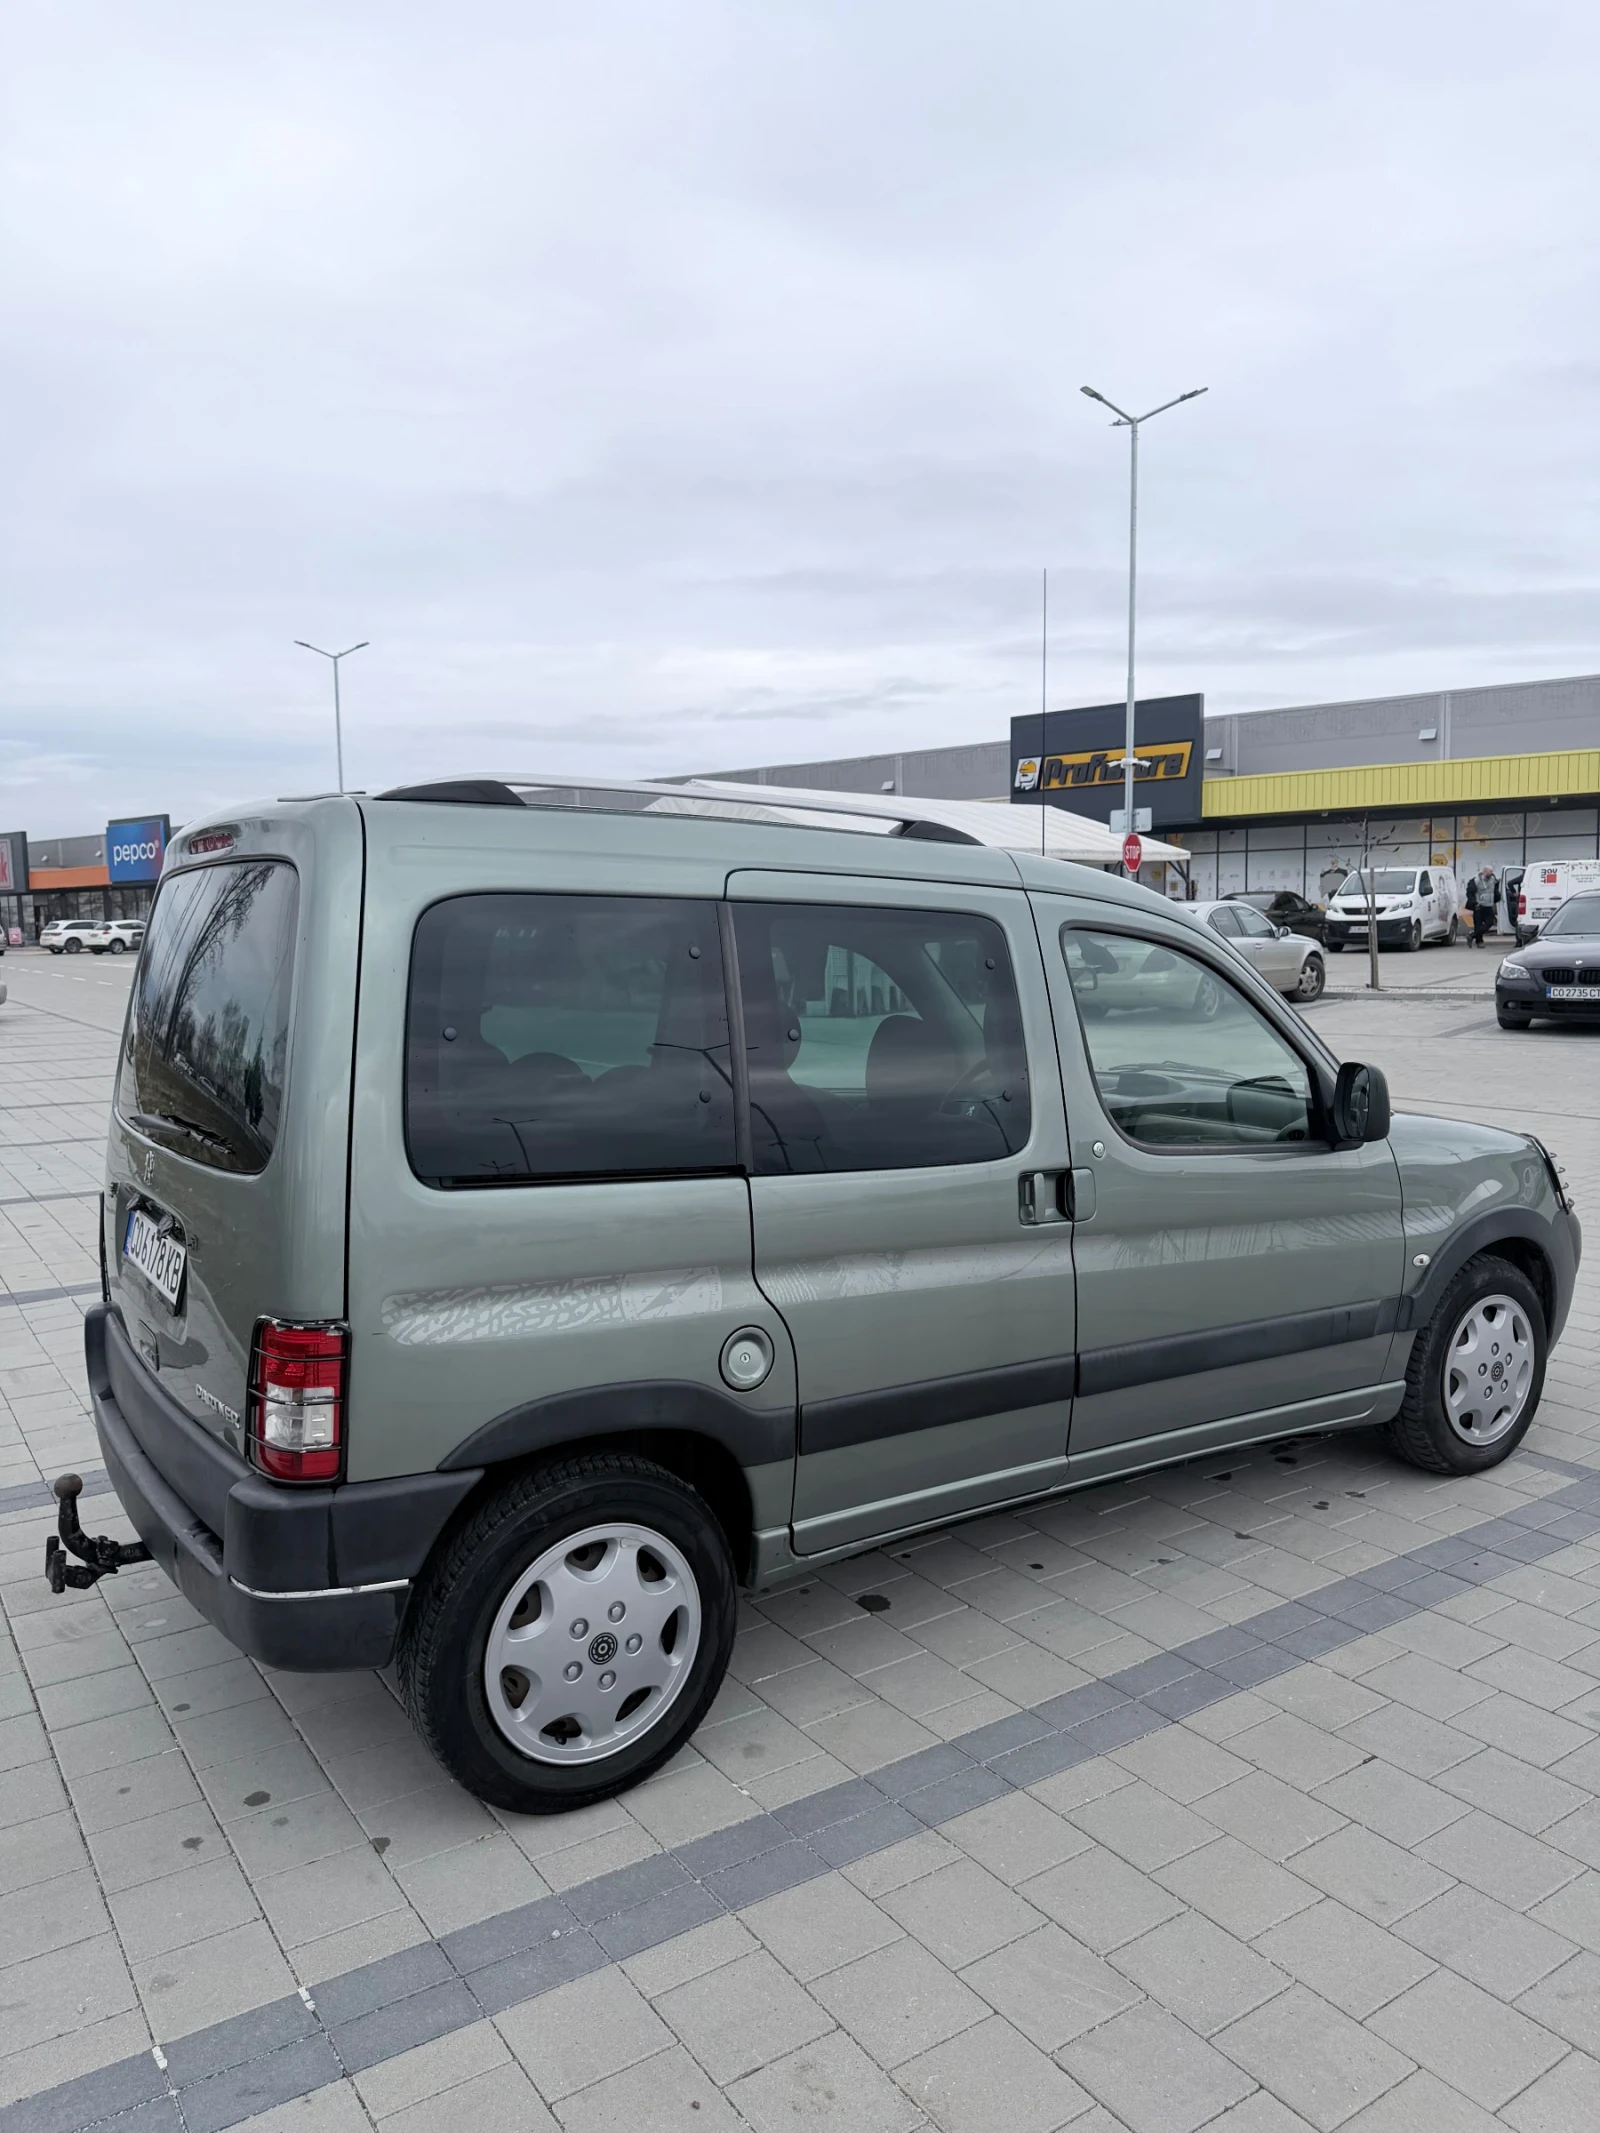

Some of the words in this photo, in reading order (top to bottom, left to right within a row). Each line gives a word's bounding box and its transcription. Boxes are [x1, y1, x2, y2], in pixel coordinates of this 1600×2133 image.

[1044, 750, 1184, 788] Profisore
[113, 842, 156, 866] pepco
[1125, 845, 1141, 860] STOP
